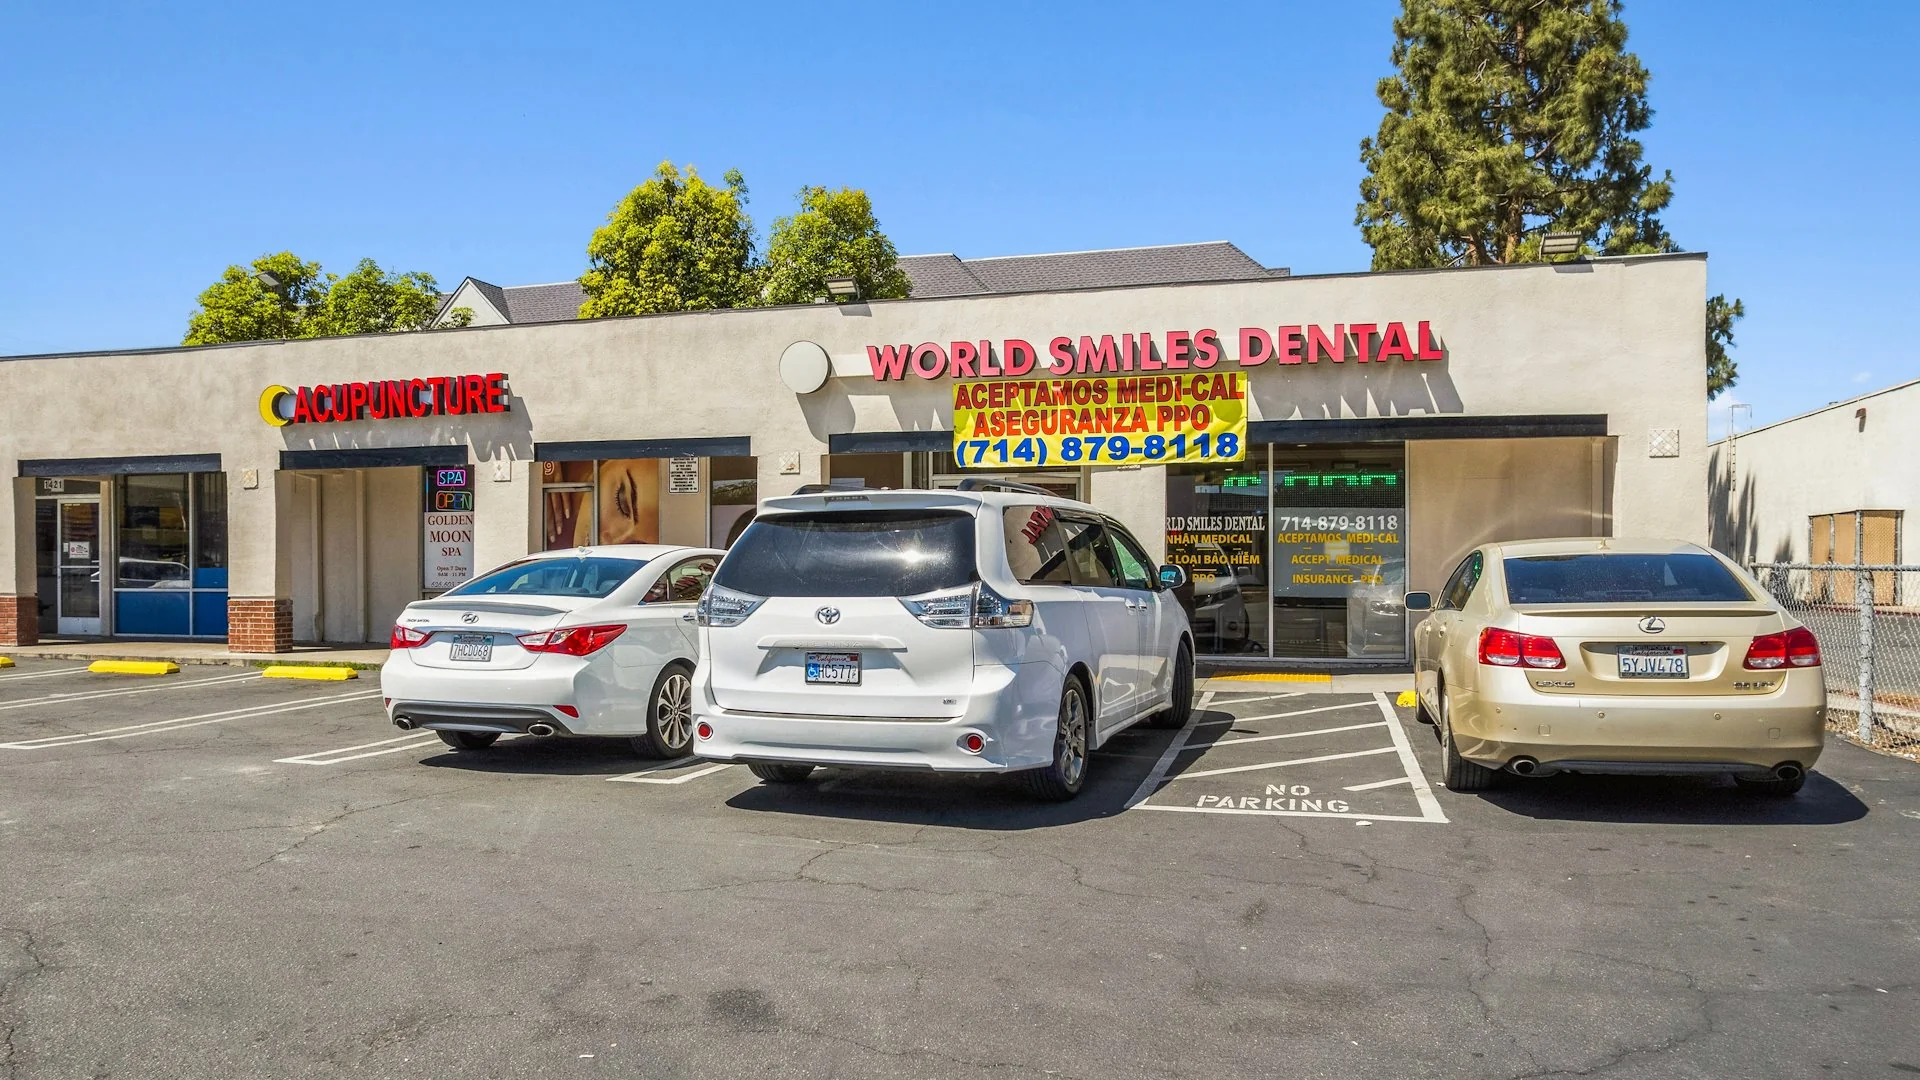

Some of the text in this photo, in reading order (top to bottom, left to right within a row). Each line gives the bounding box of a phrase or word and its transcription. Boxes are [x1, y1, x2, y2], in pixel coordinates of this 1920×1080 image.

[866, 321, 1443, 381] WORLD SMILES DENTAL
[293, 373, 509, 424] ACUPUNCTURE
[955, 373, 1245, 411] ACEPTAMOS MEDI-CAL
[973, 404, 1211, 438] ASEGURANZA PPO
[956, 432, 1240, 467] (714) 879-8118
[44, 480, 62, 489] 1421
[439, 471, 464, 485] SPA
[437, 492, 472, 509] OPEN
[427, 515, 473, 526] GOLDEN
[1166, 515, 1266, 531] RLD SMILES DENTAL
[1280, 515, 1398, 531] 714-879-8118
[429, 530, 472, 543] MOON
[1201, 534, 1253, 544] MEDICAL
[1277, 533, 1399, 544] ACEPTAMOS MEDI-CAL
[441, 547, 462, 557] SPA
[1291, 554, 1385, 565] ACCEPT MEDICAL
[436, 565, 450, 573] Open
[1192, 573, 1216, 583] PPO
[1292, 574, 1383, 584] INSURANCE PPO
[1622, 657, 1684, 673] 5YJV478
[1265, 784, 1311, 796] NO
[1196, 794, 1350, 813] PARKING
